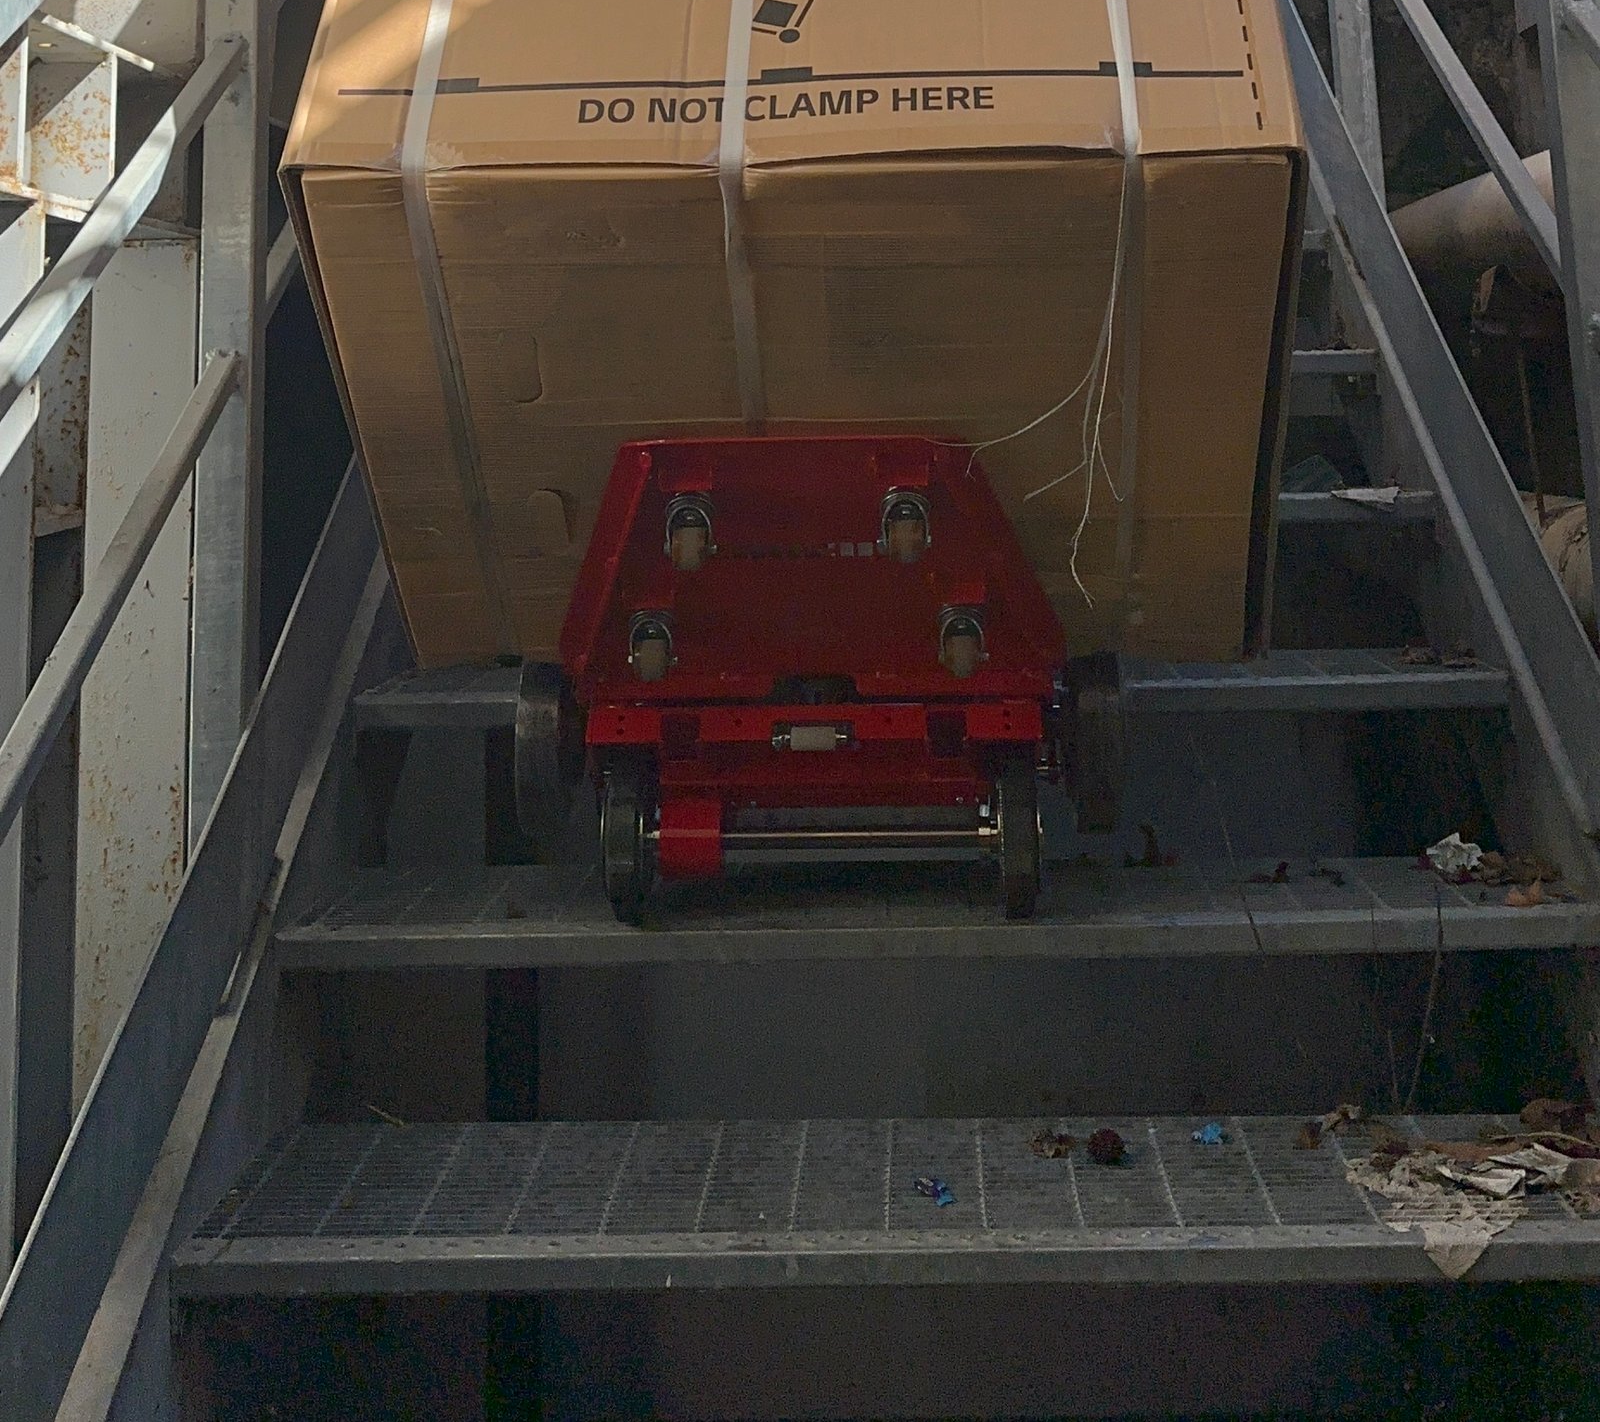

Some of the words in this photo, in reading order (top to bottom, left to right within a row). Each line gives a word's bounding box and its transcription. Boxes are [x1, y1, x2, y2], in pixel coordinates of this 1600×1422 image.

[577, 98, 635, 124] DO
[744, 89, 880, 122] CLAMP
[892, 86, 995, 112] HERE
